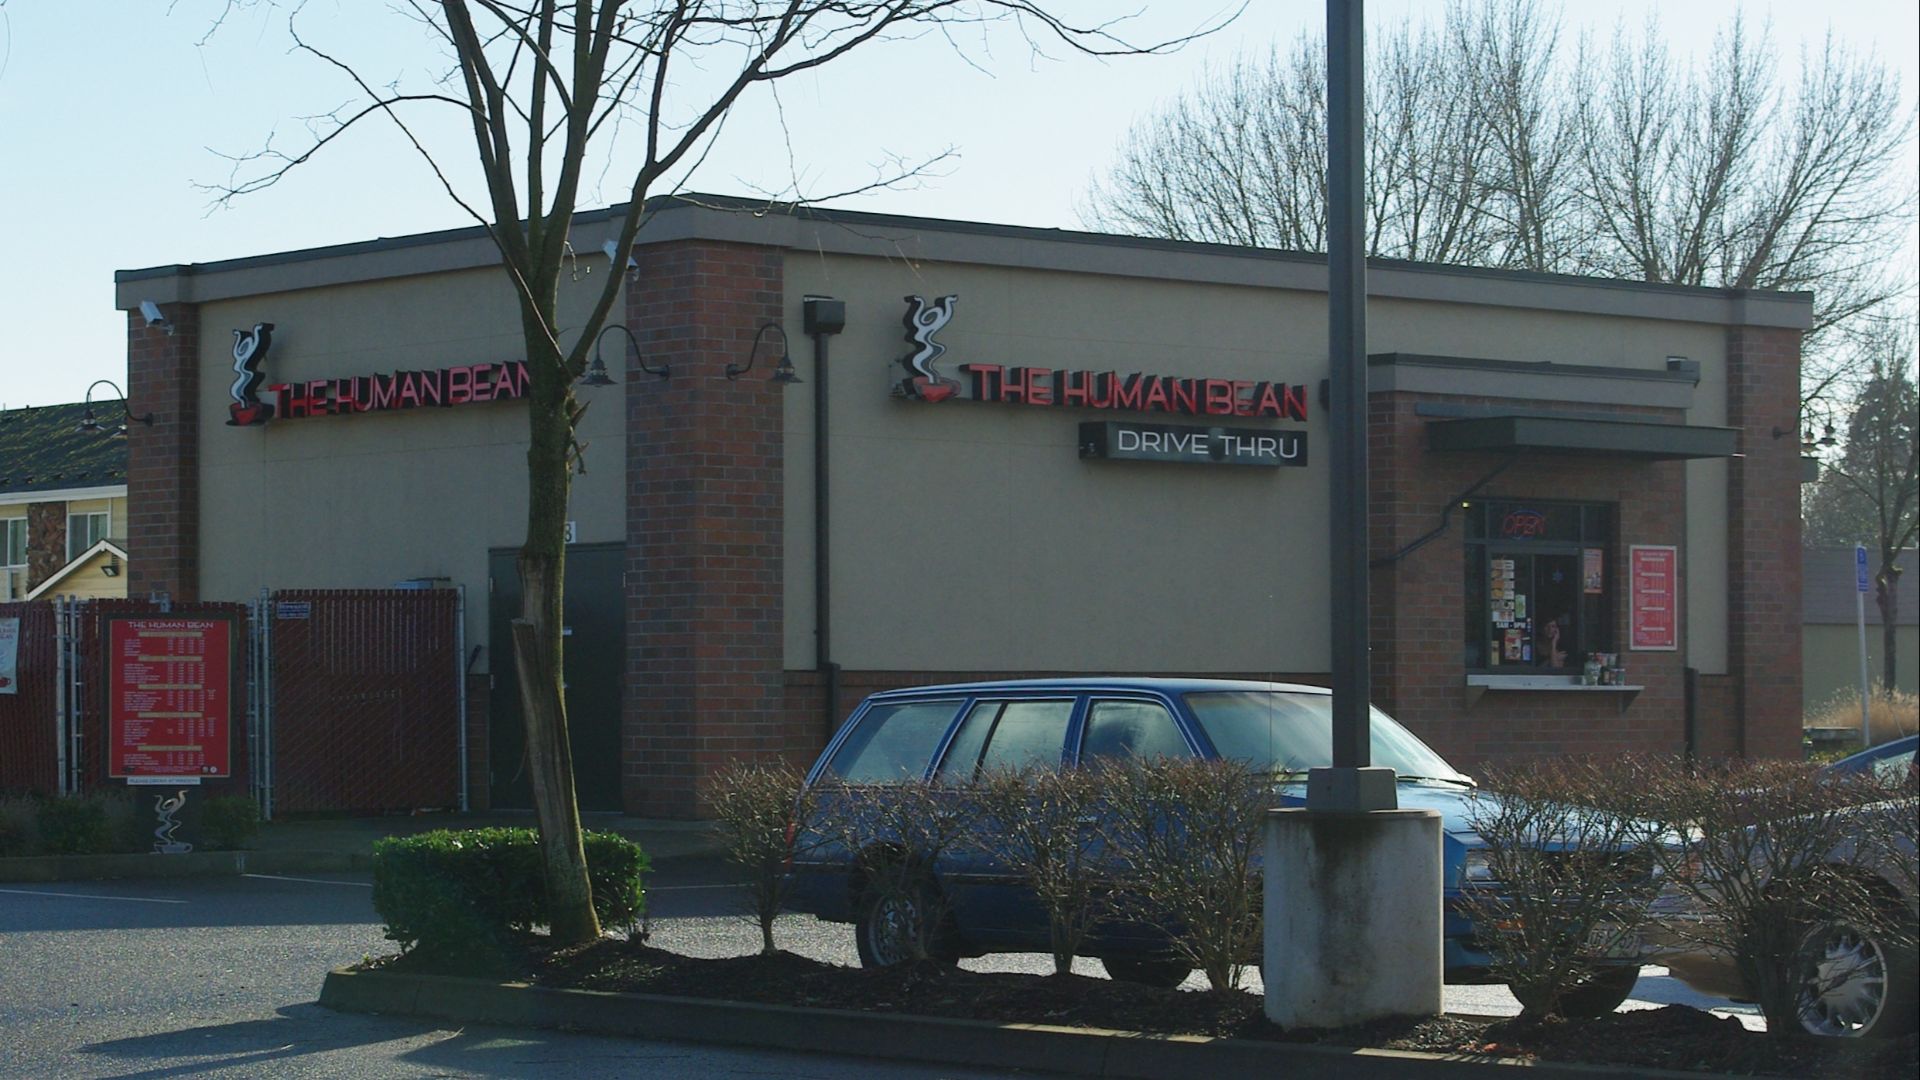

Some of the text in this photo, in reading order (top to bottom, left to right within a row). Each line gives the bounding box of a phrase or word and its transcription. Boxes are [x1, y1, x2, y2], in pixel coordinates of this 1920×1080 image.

[268, 380, 328, 418] THE
[335, 368, 441, 413] HUMAN
[968, 364, 1307, 421] THE HUMAN BEAN
[1117, 430, 1298, 459] DRIVE THRU
[1503, 515, 1546, 536] OPEN
[128, 621, 146, 629] THE
[148, 621, 185, 629] HUMAN
